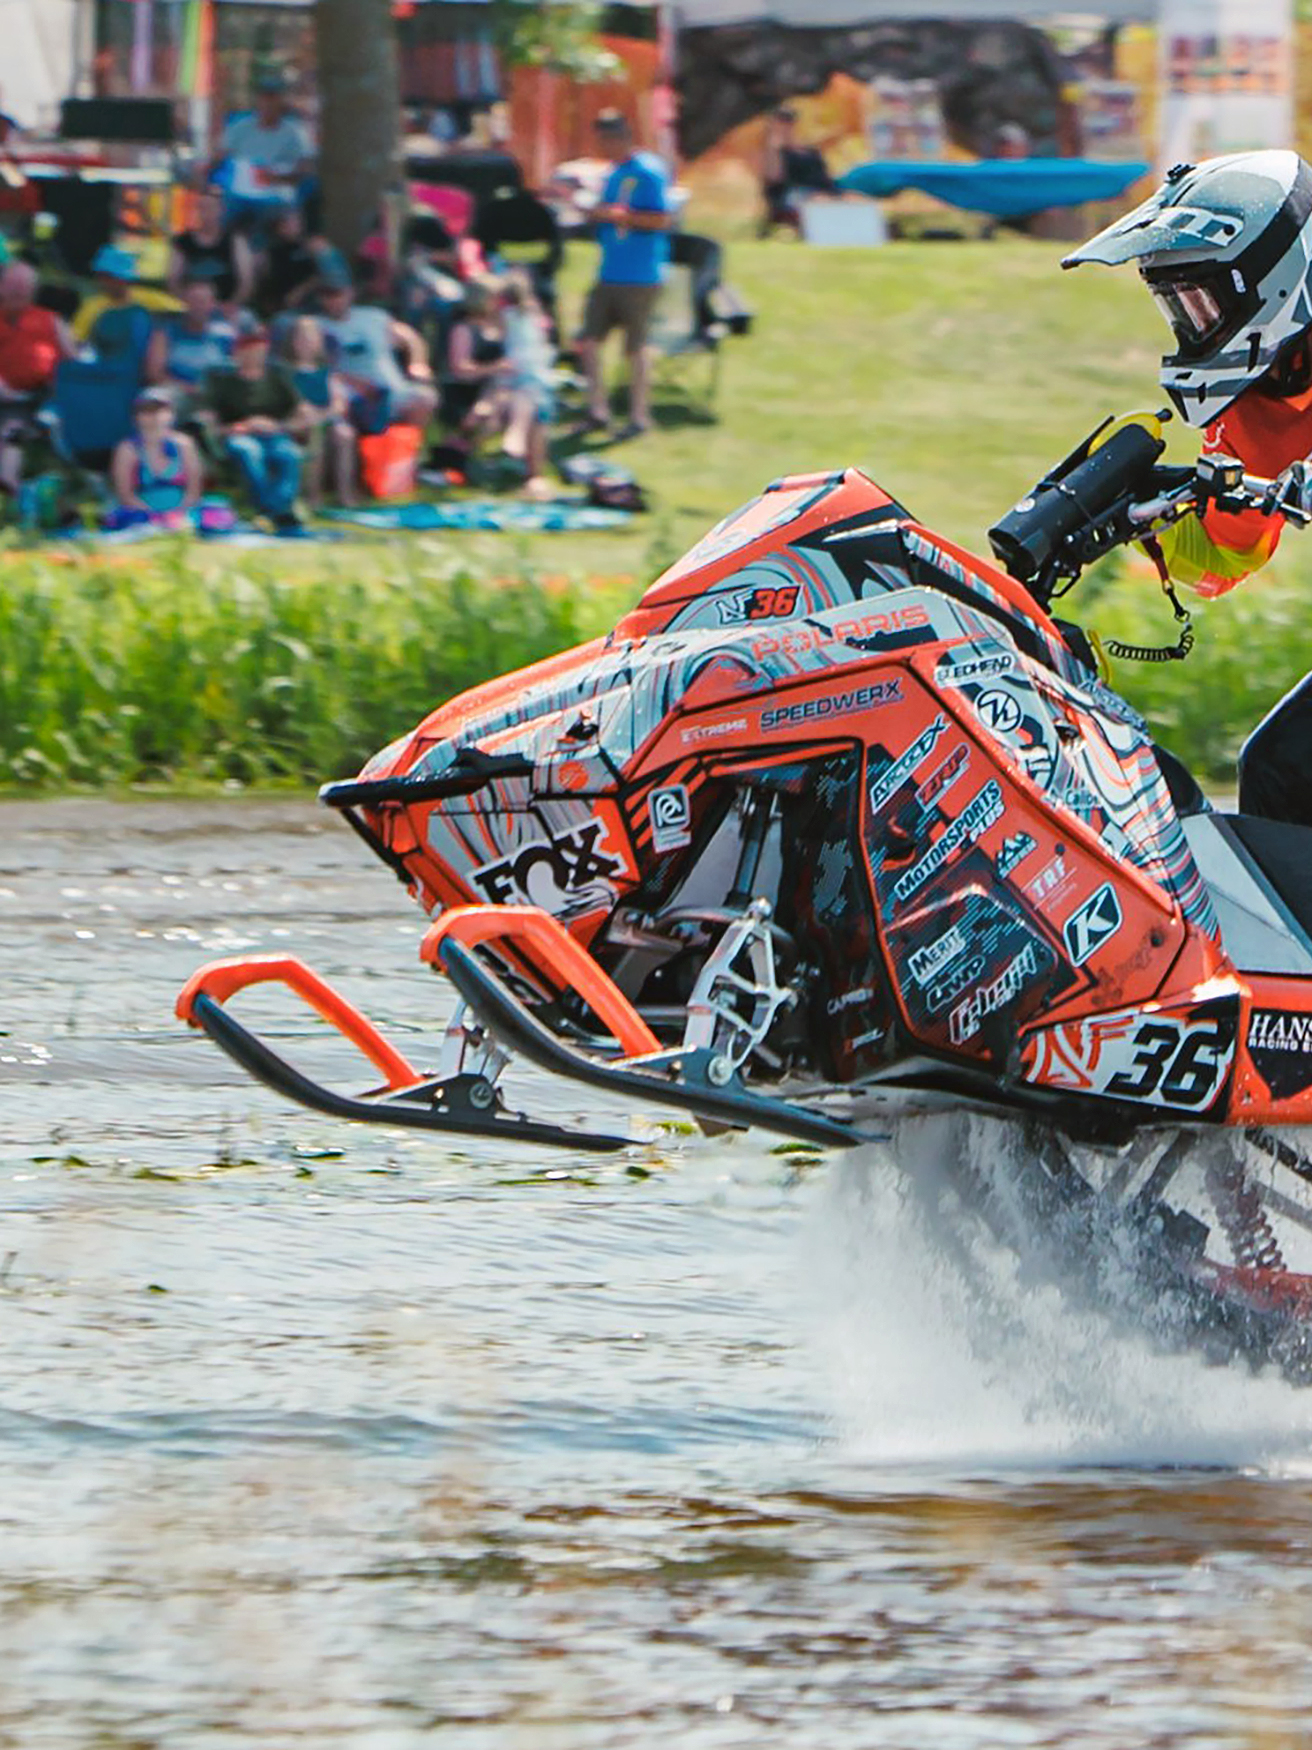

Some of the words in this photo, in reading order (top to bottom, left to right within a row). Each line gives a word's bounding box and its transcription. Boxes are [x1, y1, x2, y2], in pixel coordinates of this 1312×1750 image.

[752, 604, 930, 662] POLARIS
[760, 679, 902, 729] SPEEDWERX
[473, 822, 623, 906] FOX
[1103, 1022, 1226, 1105] 36
[1248, 1037, 1298, 1052] RACING
